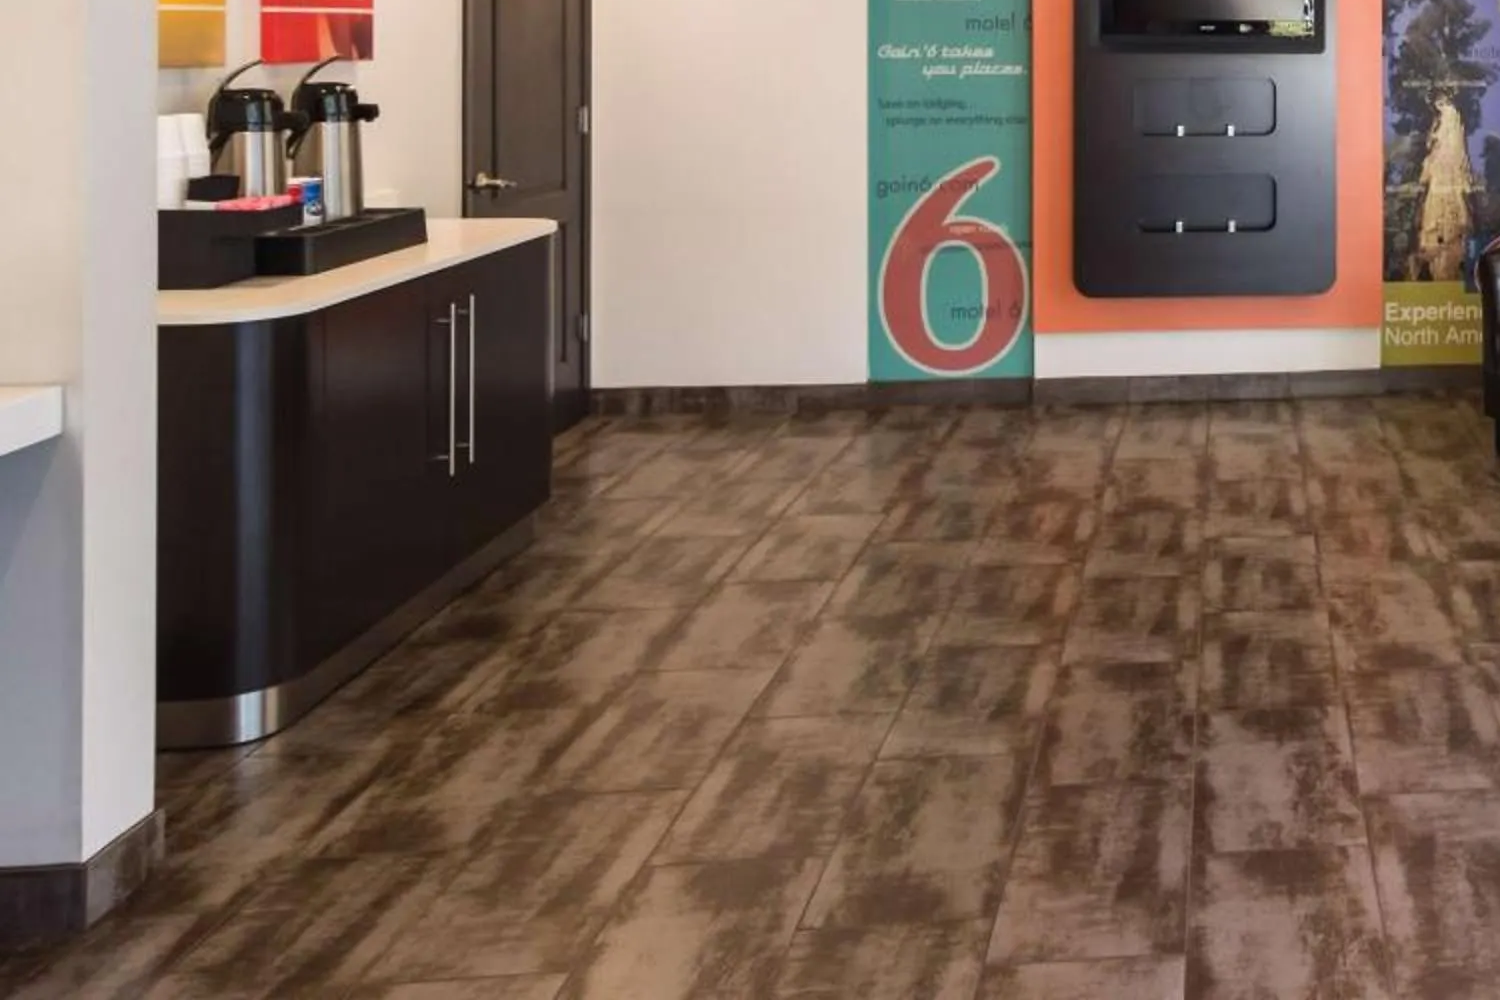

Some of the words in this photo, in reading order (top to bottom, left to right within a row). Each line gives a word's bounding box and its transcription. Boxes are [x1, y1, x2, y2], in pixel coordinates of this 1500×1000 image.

[965, 12, 1015, 32] motel
[940, 44, 995, 59] takes
[877, 155, 1030, 377] 6
[1384, 301, 1483, 326] Experien
[1385, 326, 1439, 346] North
